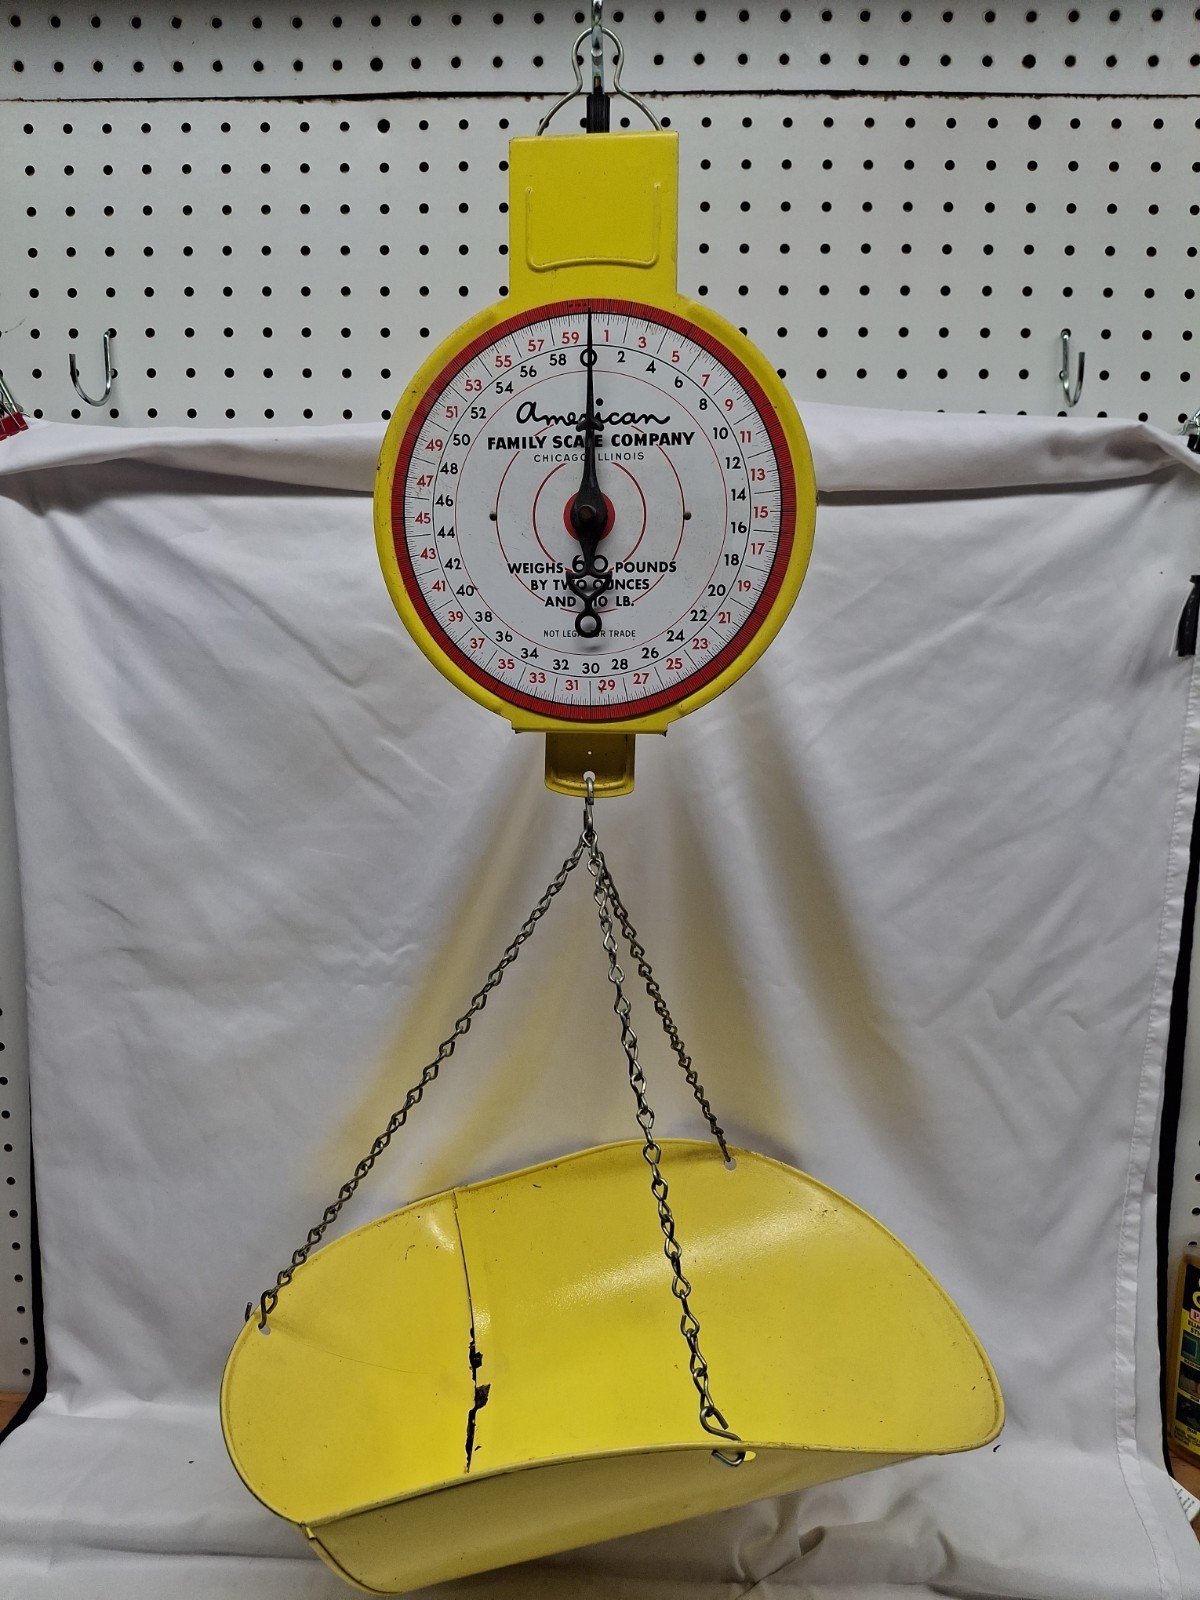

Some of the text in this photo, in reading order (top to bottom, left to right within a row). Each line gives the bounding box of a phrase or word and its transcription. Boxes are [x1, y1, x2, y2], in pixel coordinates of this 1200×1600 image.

[562, 332, 579, 344] 59
[604, 330, 608, 342] 1
[638, 336, 646, 348] 3
[528, 339, 544, 352] 57
[495, 355, 512, 368] 55
[549, 353, 566, 366] 58
[579, 347, 597, 365] 0
[617, 351, 625, 363] 2
[672, 351, 680, 363] 5
[520, 365, 537, 378] 56
[645, 360, 656, 373] 4
[465, 379, 482, 392] 53
[675, 376, 683, 388] 6
[702, 374, 710, 387] 7
[496, 381, 514, 394] 54
[699, 398, 707, 410] 8
[725, 399, 733, 411] 9
[446, 406, 458, 418] 51
[470, 406, 487, 420] 52
[713, 426, 729, 440] 10
[740, 430, 752, 443] 11
[425, 438, 443, 452] 49
[452, 433, 471, 447] 50
[487, 431, 695, 450] FAMILY SCAE COMPANY
[594, 452, 645, 462] LLINOIS
[725, 455, 742, 469] 12
[440, 462, 459, 476] 48
[750, 467, 765, 482] 13
[416, 474, 434, 489] 47
[731, 487, 747, 501] 14
[435, 494, 453, 508] 46
[415, 511, 431, 525] 45
[753, 505, 769, 519] 15
[437, 525, 456, 539] 44
[730, 521, 747, 535] 16
[419, 546, 437, 560] 43
[751, 543, 765, 555] 17
[444, 556, 462, 570] 42
[508, 555, 677, 574] WEIGHS 60 POUNDS
[724, 553, 740, 567] 18
[432, 579, 446, 593] 41
[456, 583, 475, 597] 40
[530, 579, 548, 591] BY
[707, 583, 726, 597] 20
[738, 580, 751, 592] 19
[544, 595, 635, 608] AND 10 LB.
[448, 610, 464, 624] 39
[475, 610, 493, 624] 38
[689, 609, 708, 622] 22
[718, 612, 731, 623] 21
[496, 631, 513, 642] 36
[543, 629, 560, 638] NOT
[562, 629, 585, 638] LEG
[609, 628, 636, 638] TRADE
[666, 629, 685, 643] 24
[470, 638, 485, 649] 37
[692, 636, 709, 651] 23
[521, 647, 539, 659] 34
[641, 647, 659, 659] 26
[498, 659, 515, 669] 35
[553, 659, 569, 670] 32
[582, 663, 600, 674] 30
[611, 659, 628, 670] 28
[666, 658, 682, 670] 25
[529, 672, 546, 683] 33
[633, 673, 649, 684] 27
[565, 680, 578, 691] 31
[598, 679, 615, 691] 29
